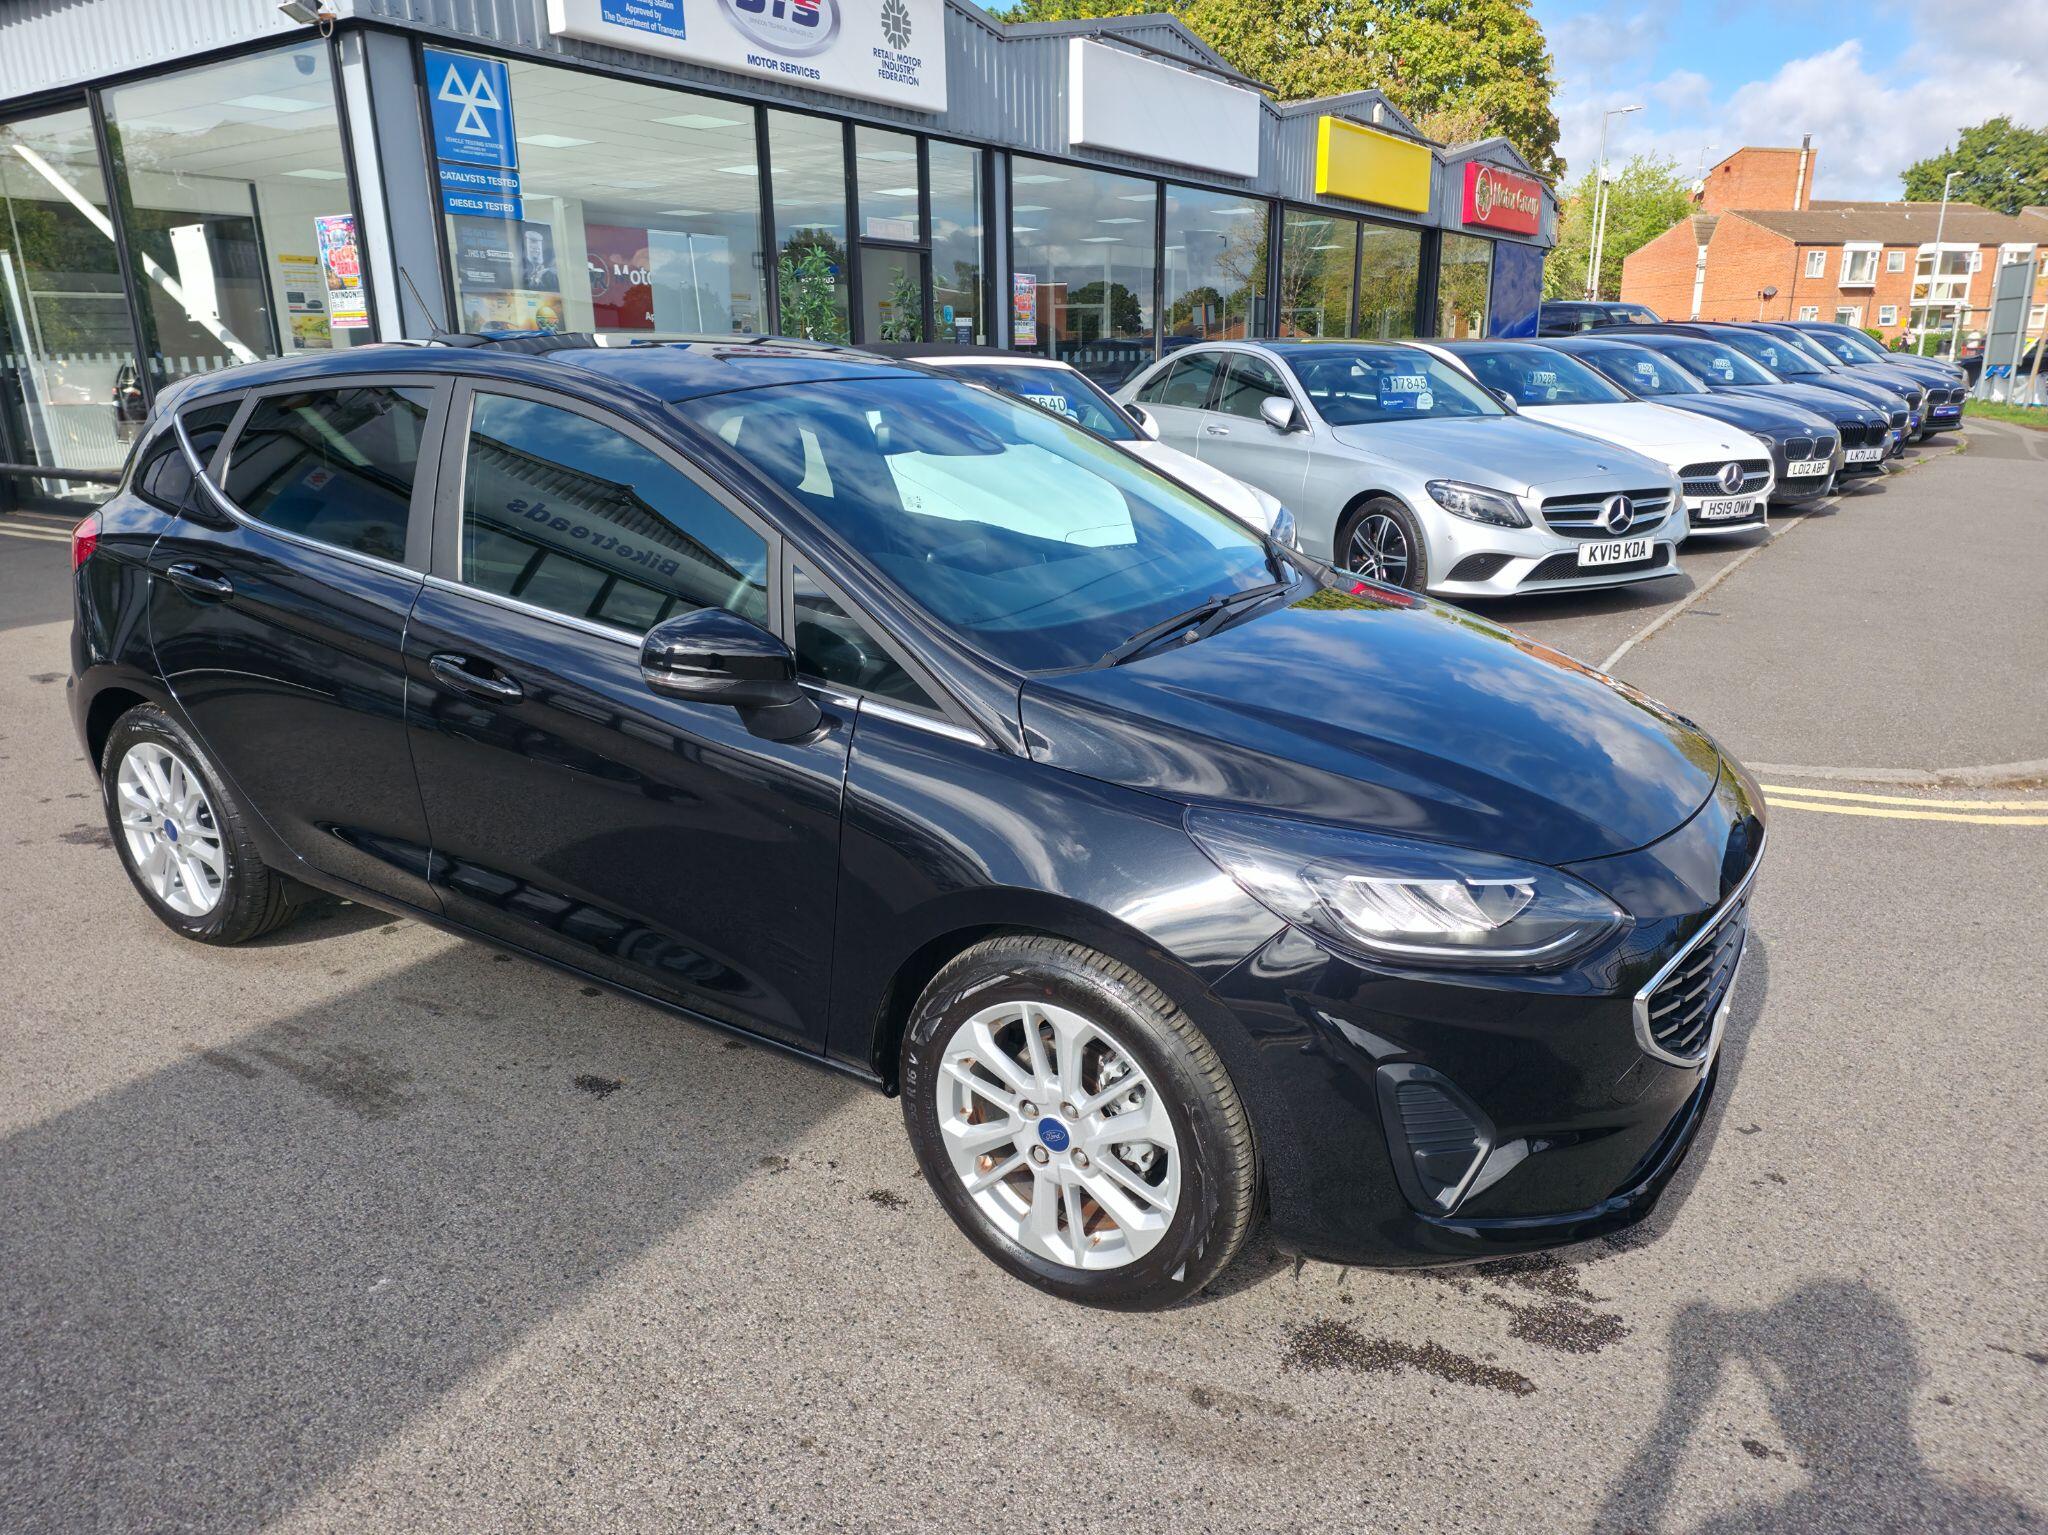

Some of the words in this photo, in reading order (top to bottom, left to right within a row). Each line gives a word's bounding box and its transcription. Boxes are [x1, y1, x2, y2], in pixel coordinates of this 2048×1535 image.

[625, 3, 654, 18] Approved
[654, 9, 662, 21] by
[603, 10, 616, 21] The
[616, 13, 650, 30] Department
[650, 22, 657, 31] of
[658, 23, 685, 38] Transport
[873, 47, 896, 62] RETAIL
[897, 52, 922, 68] MOTOR
[747, 53, 778, 71] MOTOR
[780, 61, 821, 80] SERVICES
[881, 60, 915, 75] INDUSTRY
[878, 68, 920, 87] FEDERATION
[440, 171, 486, 184] CATALYSTS
[487, 176, 518, 188] TESTED
[449, 198, 483, 209] DIESELS
[485, 202, 514, 212] TESTED
[331, 291, 357, 300] SWINDON
[1811, 462, 1826, 474] ABF
[1708, 501, 1733, 516] HS19
[1588, 543, 1621, 562] KV19
[1623, 540, 1646, 559] KDA
